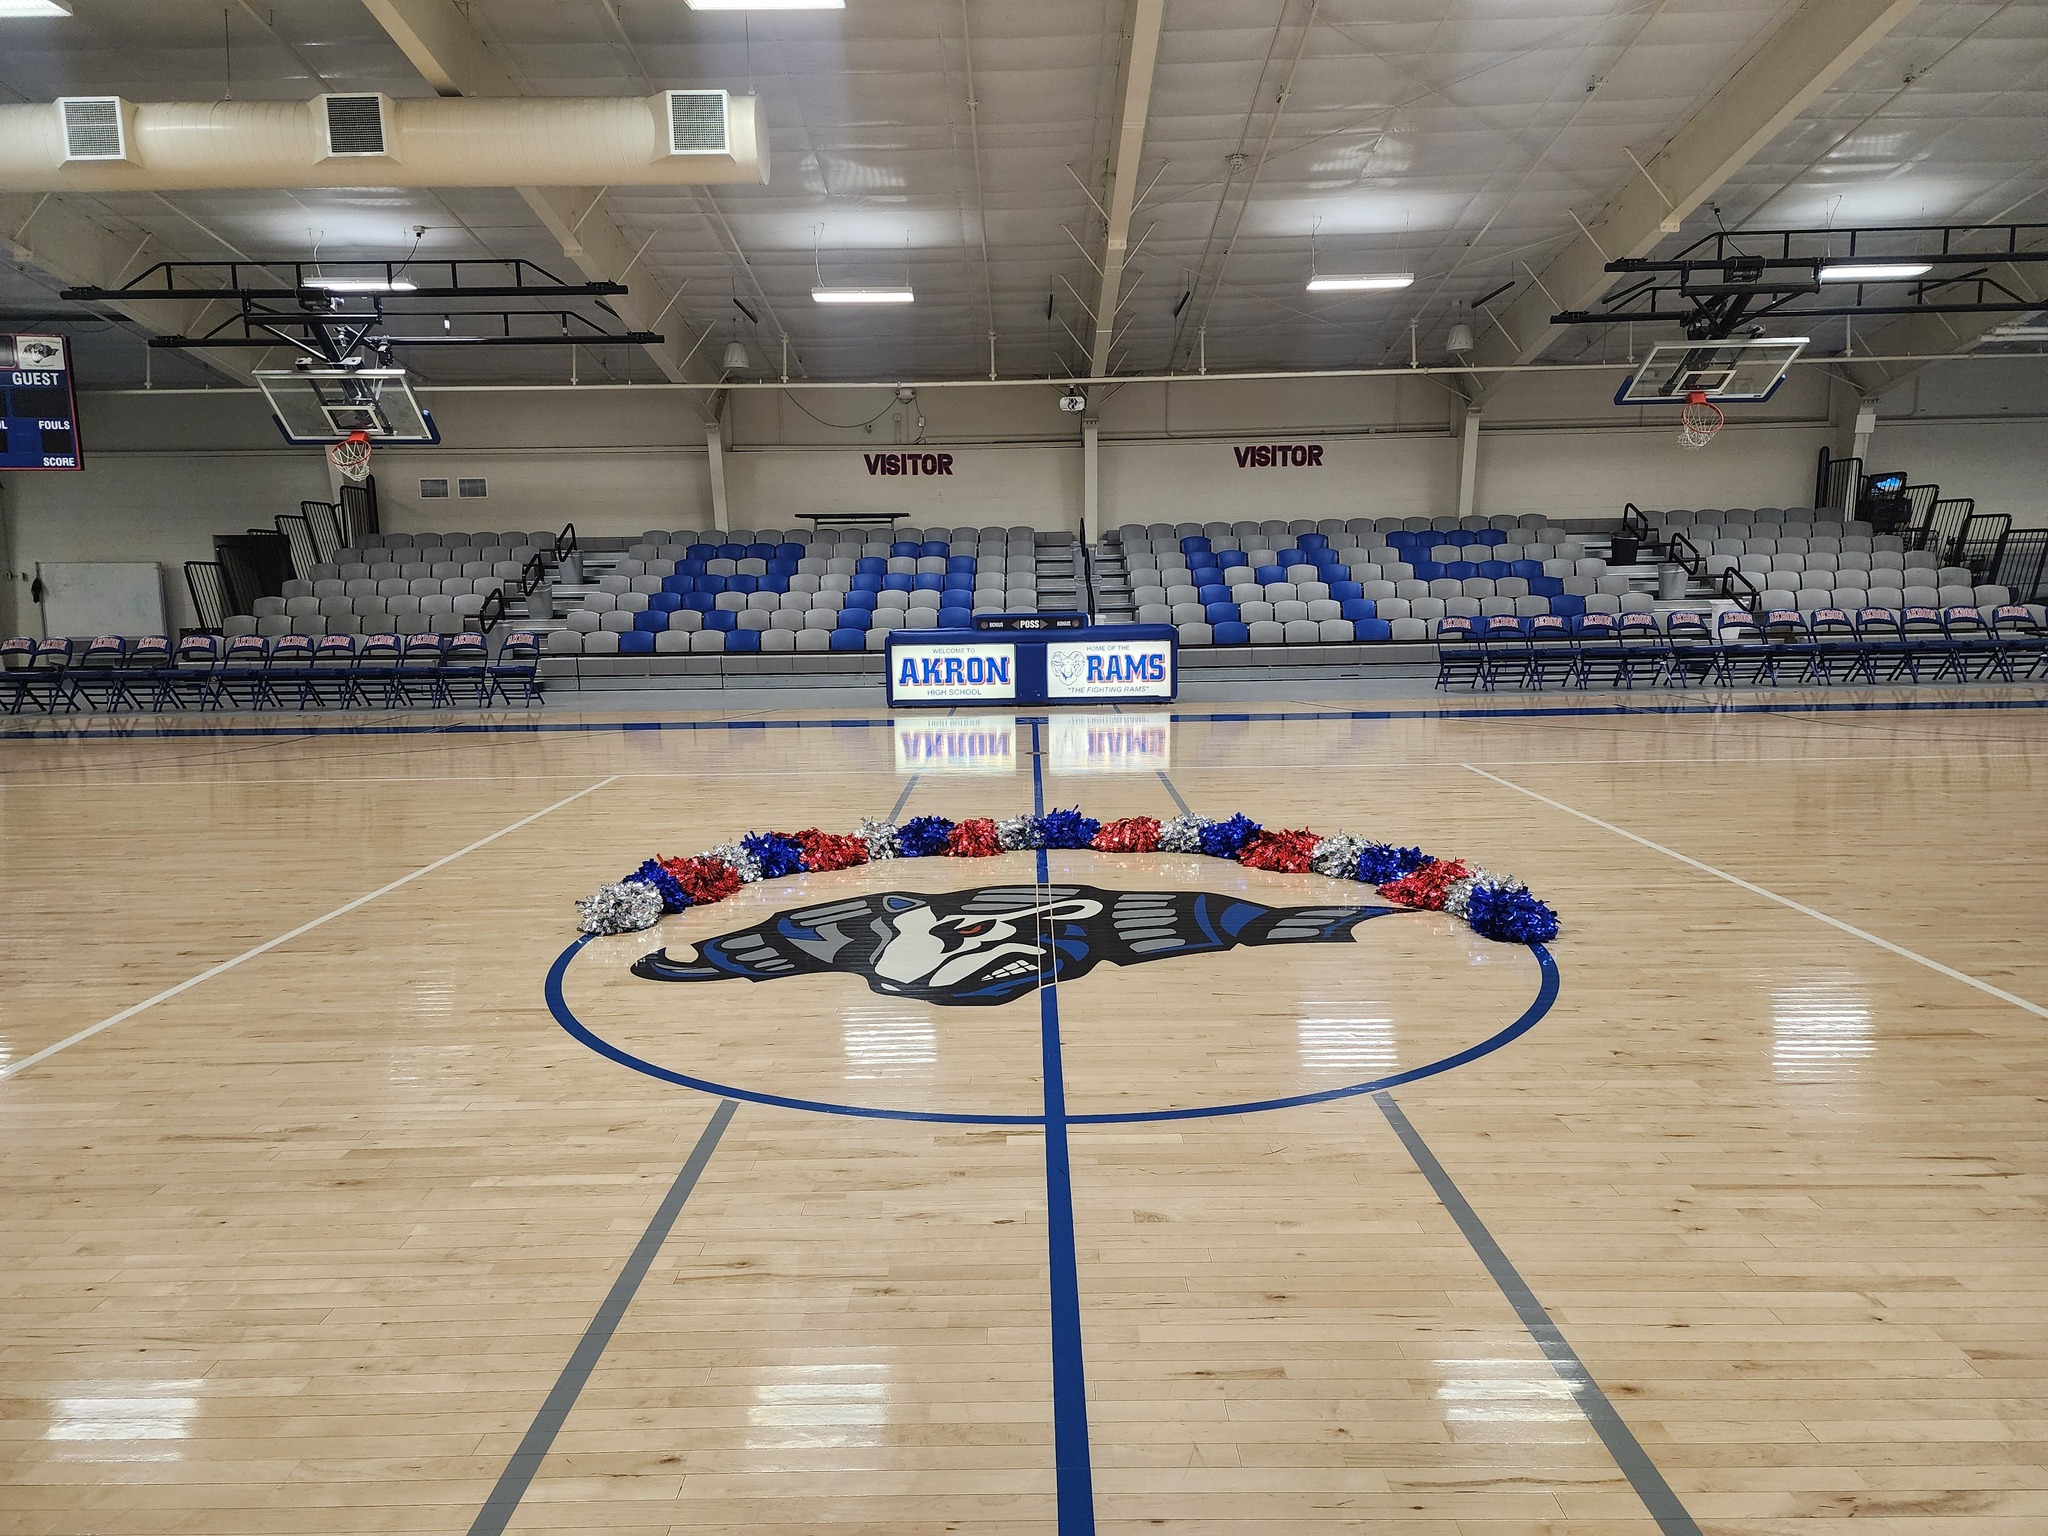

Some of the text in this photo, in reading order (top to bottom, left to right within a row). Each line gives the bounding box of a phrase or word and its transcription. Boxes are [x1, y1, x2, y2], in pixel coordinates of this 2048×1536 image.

[12, 372, 59, 386] GUEST
[38, 420, 70, 430] FOULS
[43, 458, 75, 466] SCORE
[863, 453, 954, 476] VISITOR
[1234, 444, 1323, 468] VISITOR
[1020, 620, 1040, 629] POSS
[898, 656, 1010, 686] AKRON
[1086, 654, 1166, 683] RAMS
